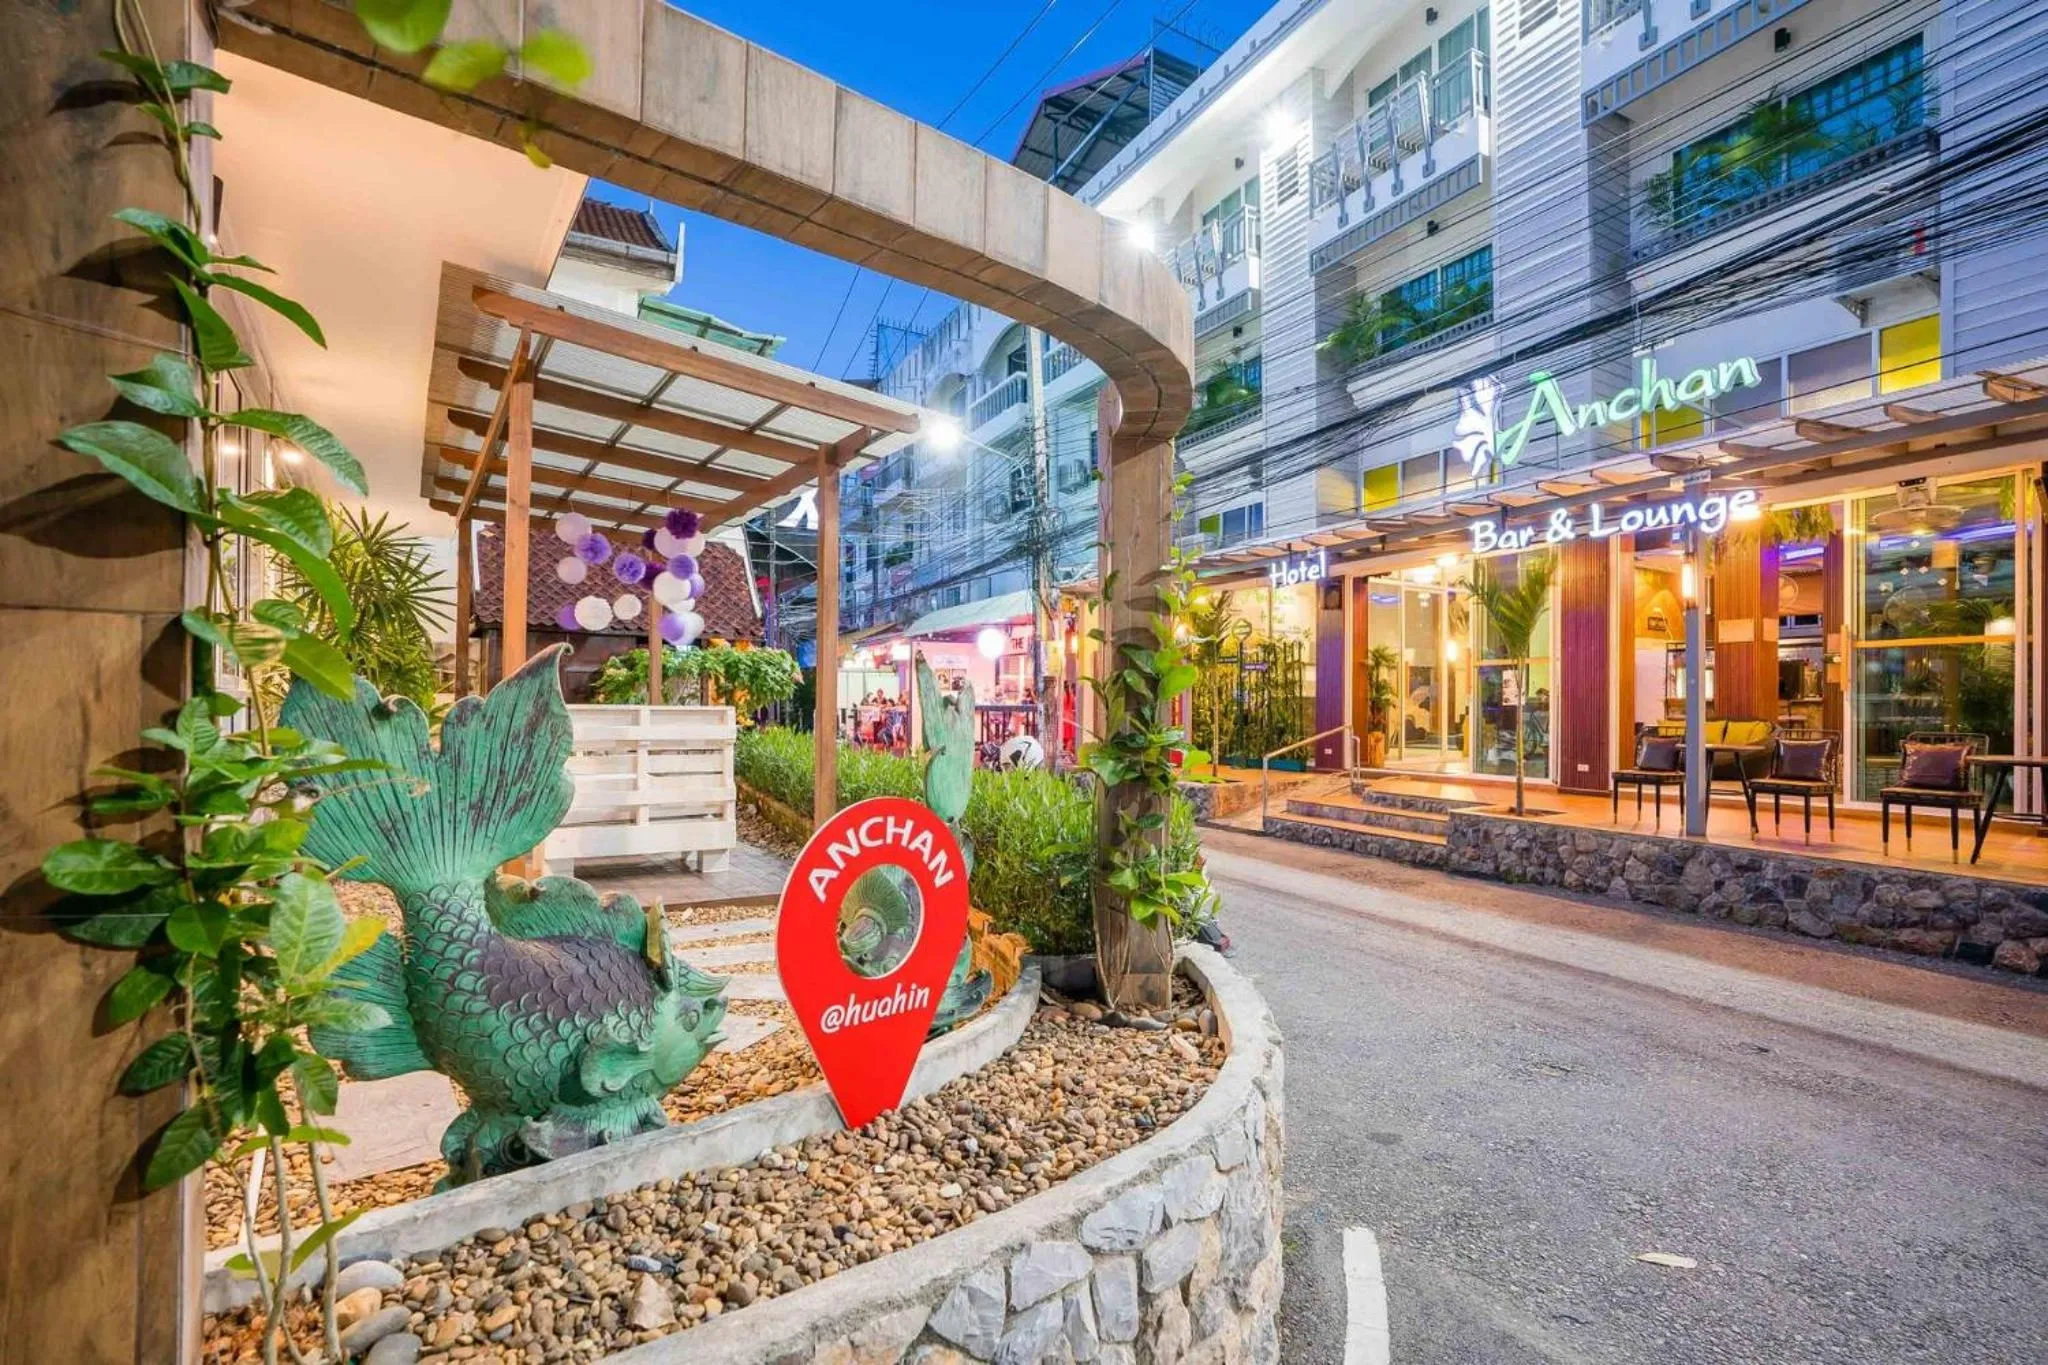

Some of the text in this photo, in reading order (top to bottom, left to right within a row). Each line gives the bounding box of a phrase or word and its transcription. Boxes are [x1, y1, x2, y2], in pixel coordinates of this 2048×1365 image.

[1495, 356, 1762, 466] Anchan
[1470, 489, 1763, 553] Bar & Lounge
[1269, 547, 1327, 590] Hotel
[808, 815, 955, 903] ANCHAN
[820, 982, 931, 1034] @huahin
